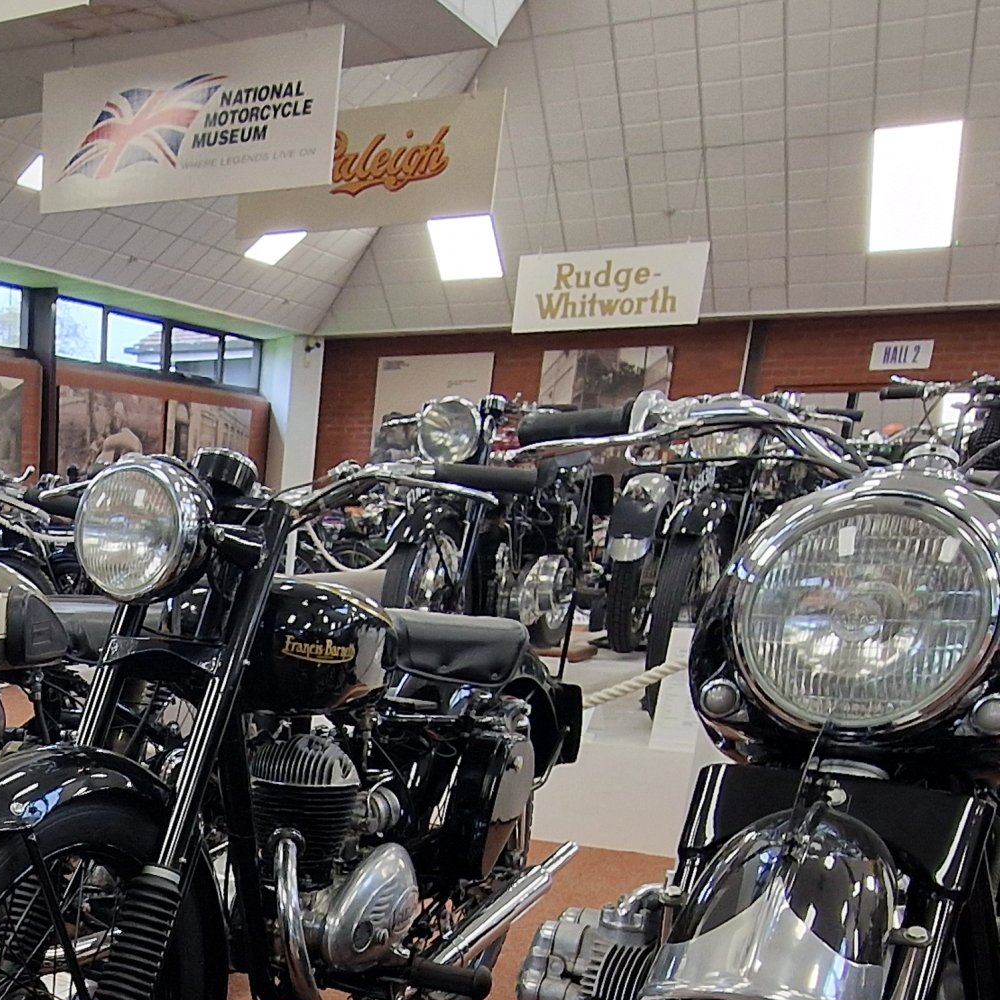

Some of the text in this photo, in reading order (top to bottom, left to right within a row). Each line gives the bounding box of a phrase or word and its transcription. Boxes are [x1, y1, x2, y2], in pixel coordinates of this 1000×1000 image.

[220, 81, 305, 107] NATIONAL
[204, 99, 313, 128] MOTORCYCLE
[192, 125, 268, 149] MUSEUM
[182, 148, 317, 169] WHERE LEGENDS LIVE ON
[553, 260, 662, 293] Rudge-
[535, 286, 677, 320] Whitworth
[882, 344, 921, 364] HALL 2
